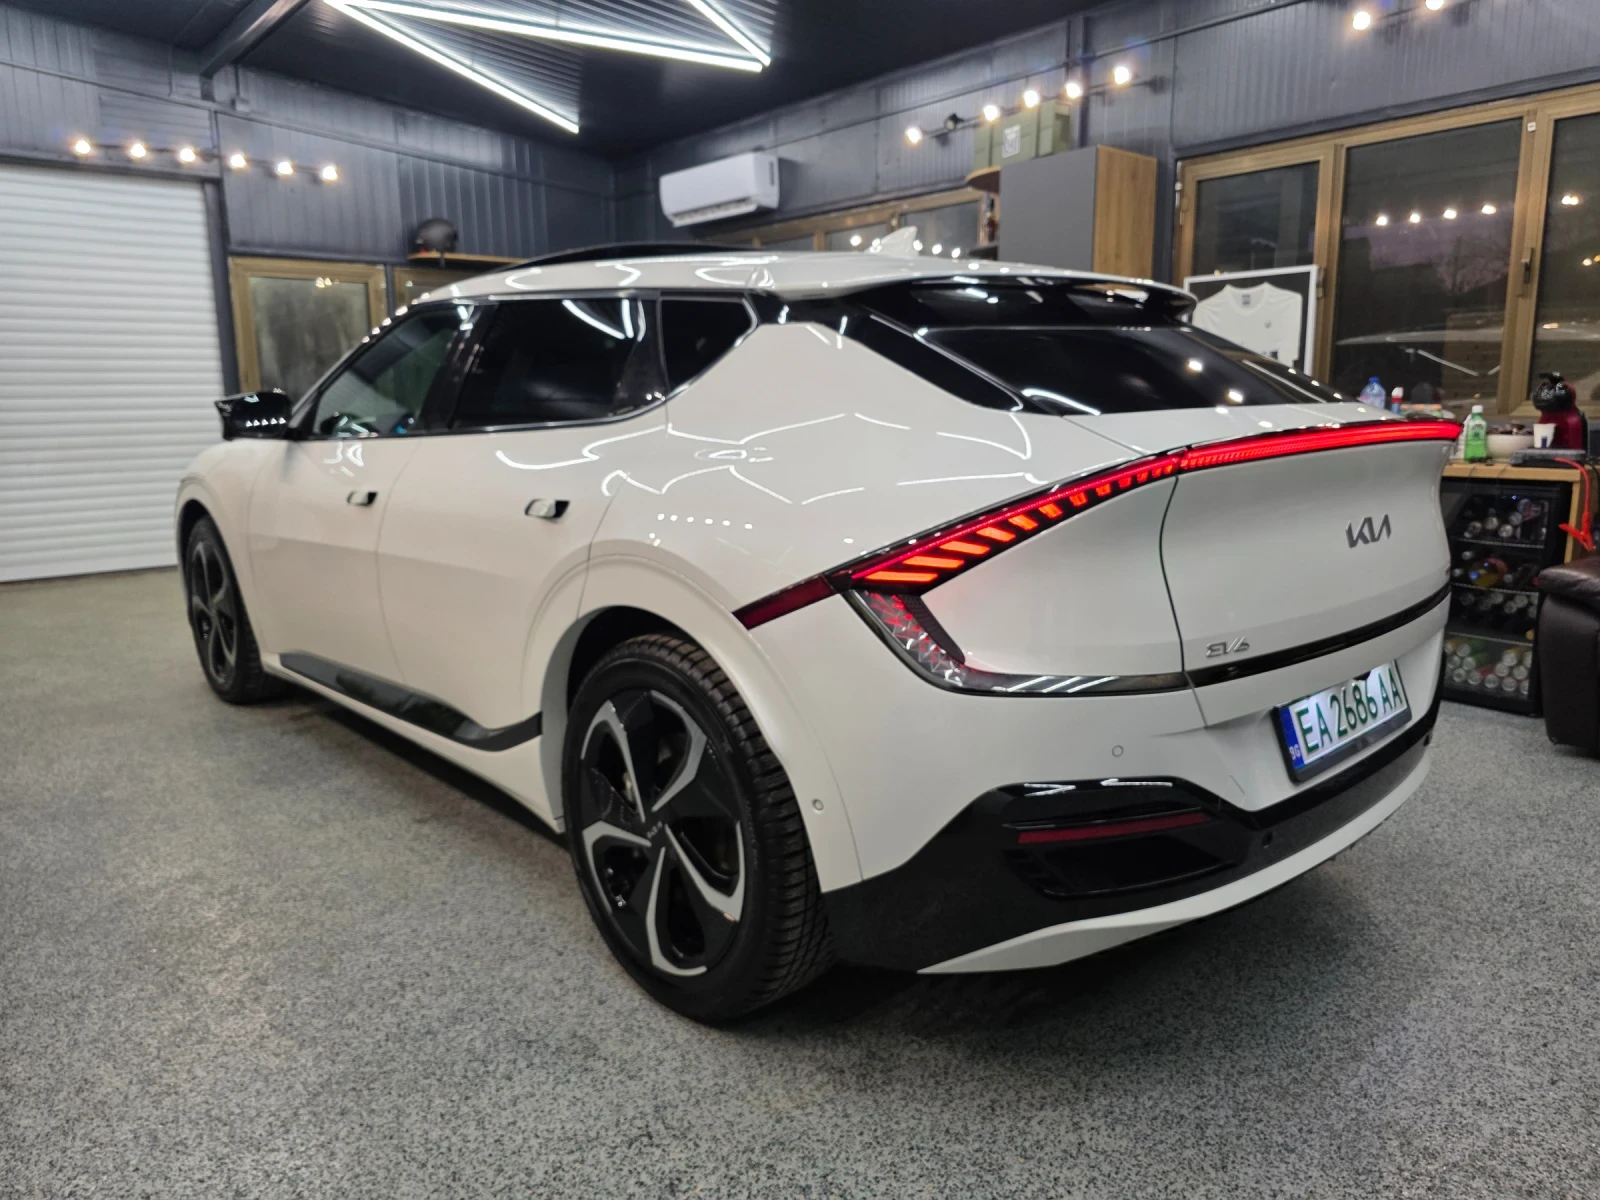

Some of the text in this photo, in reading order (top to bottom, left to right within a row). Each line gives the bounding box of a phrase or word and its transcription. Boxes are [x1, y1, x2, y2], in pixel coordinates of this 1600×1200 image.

[1345, 513, 1391, 548] KIA
[1206, 636, 1249, 658] EV6
[1295, 667, 1403, 753] EA 2686 AA
